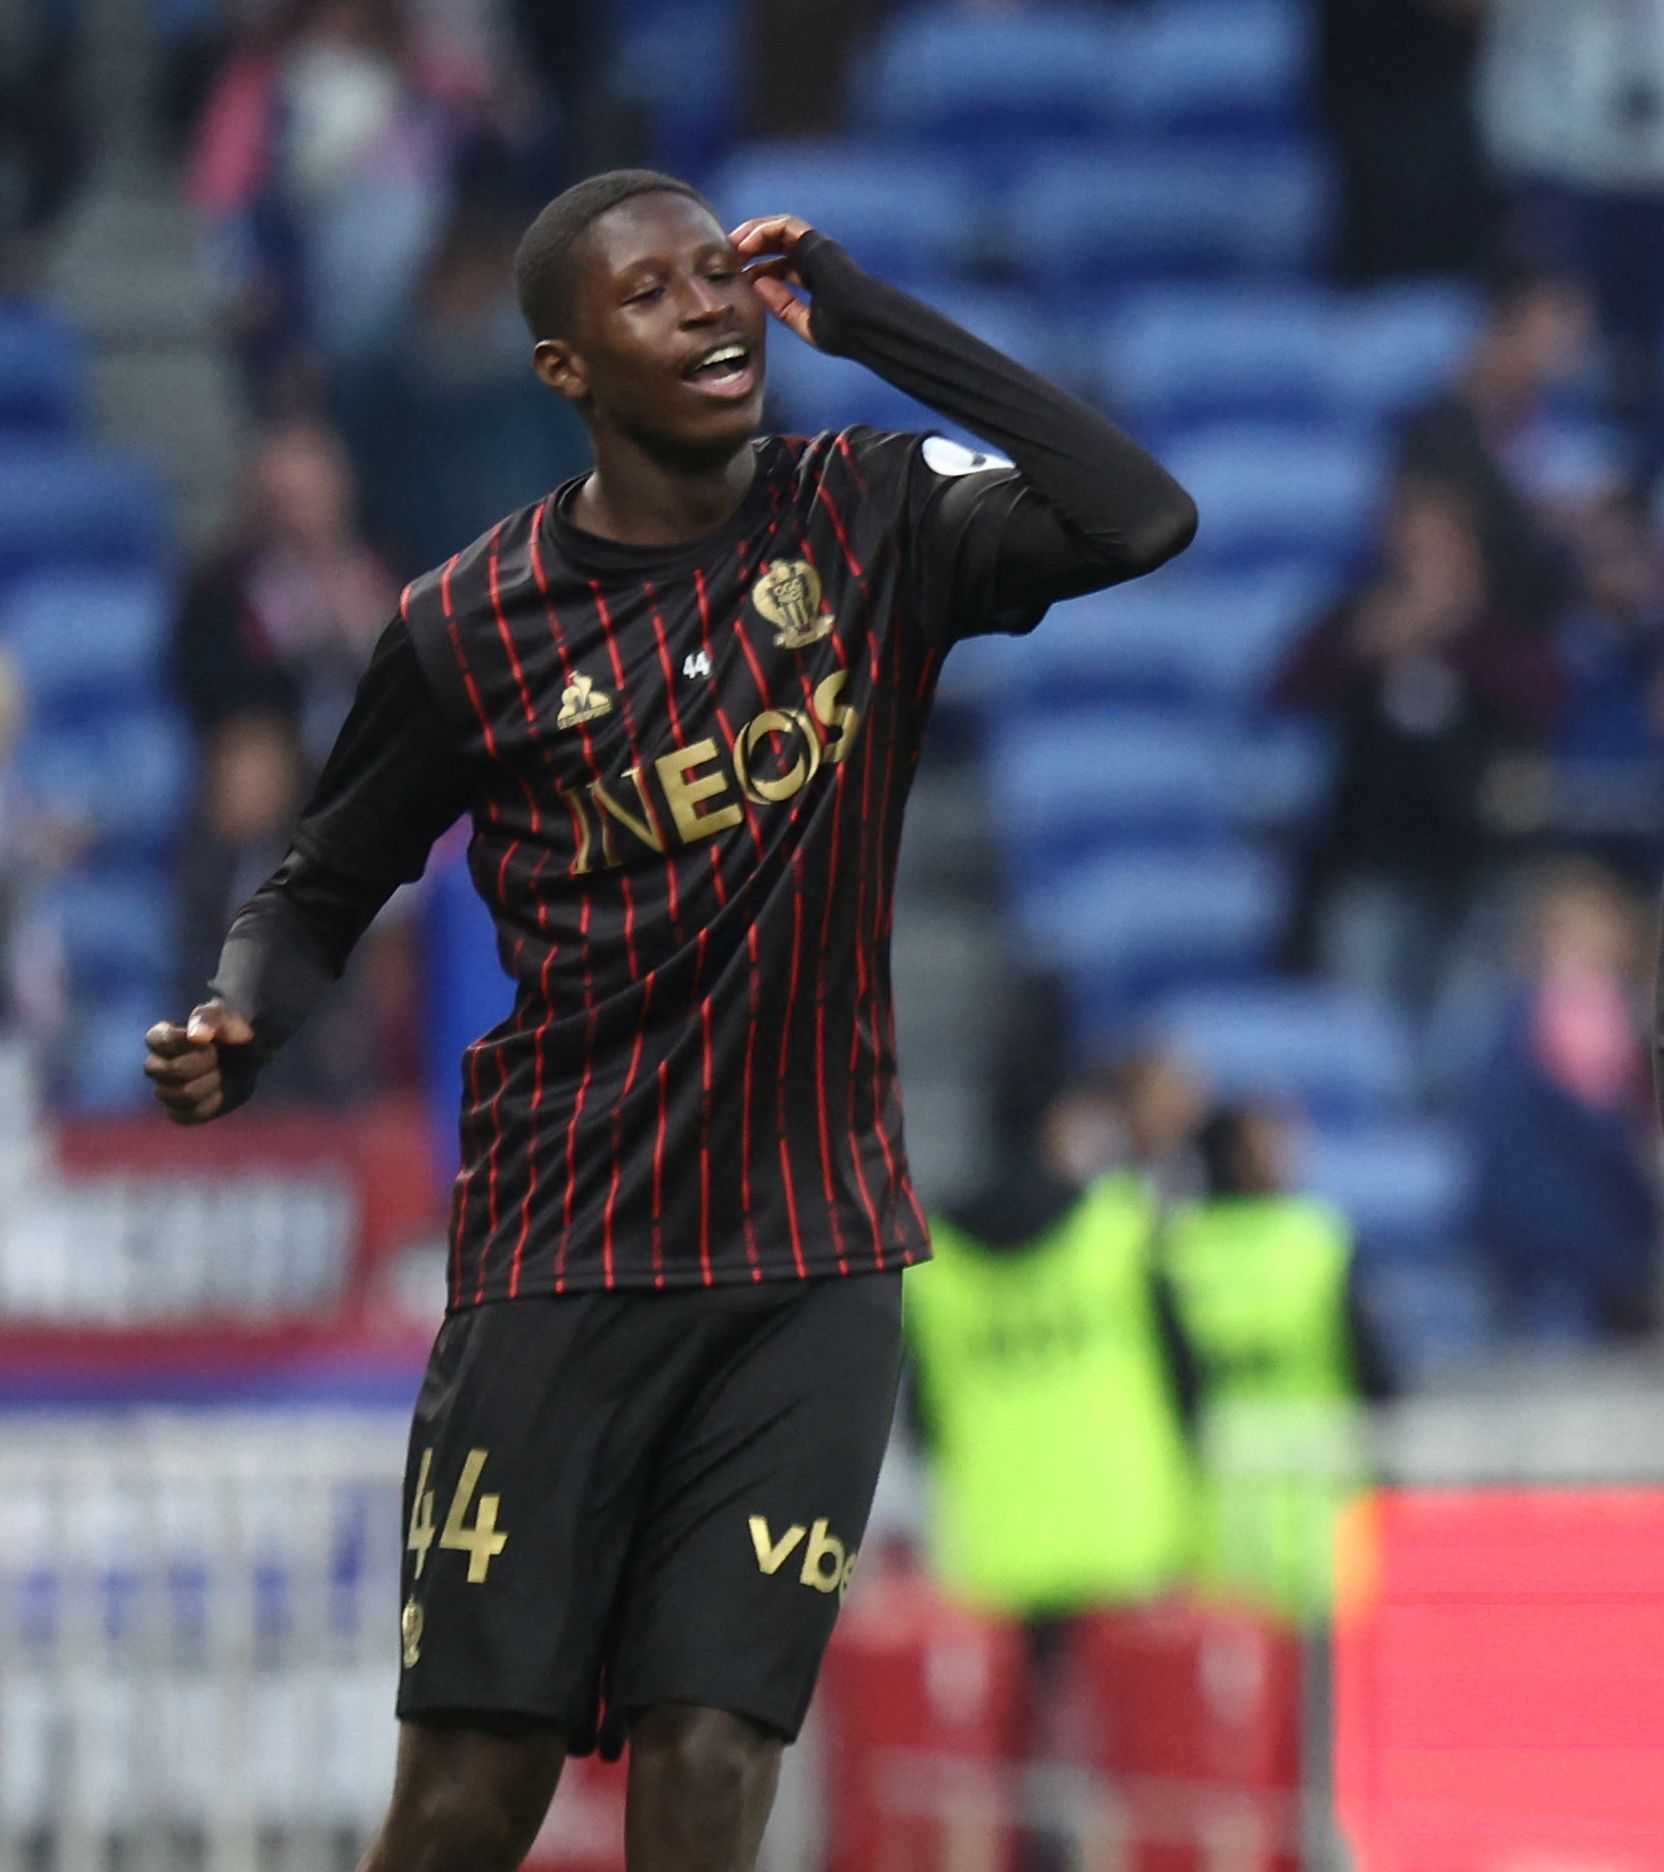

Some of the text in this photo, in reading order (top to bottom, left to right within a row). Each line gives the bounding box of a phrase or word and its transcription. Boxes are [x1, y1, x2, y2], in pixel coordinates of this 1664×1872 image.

[682, 651, 712, 678] 44
[562, 669, 859, 874] INEOS
[407, 1448, 509, 1584] 44
